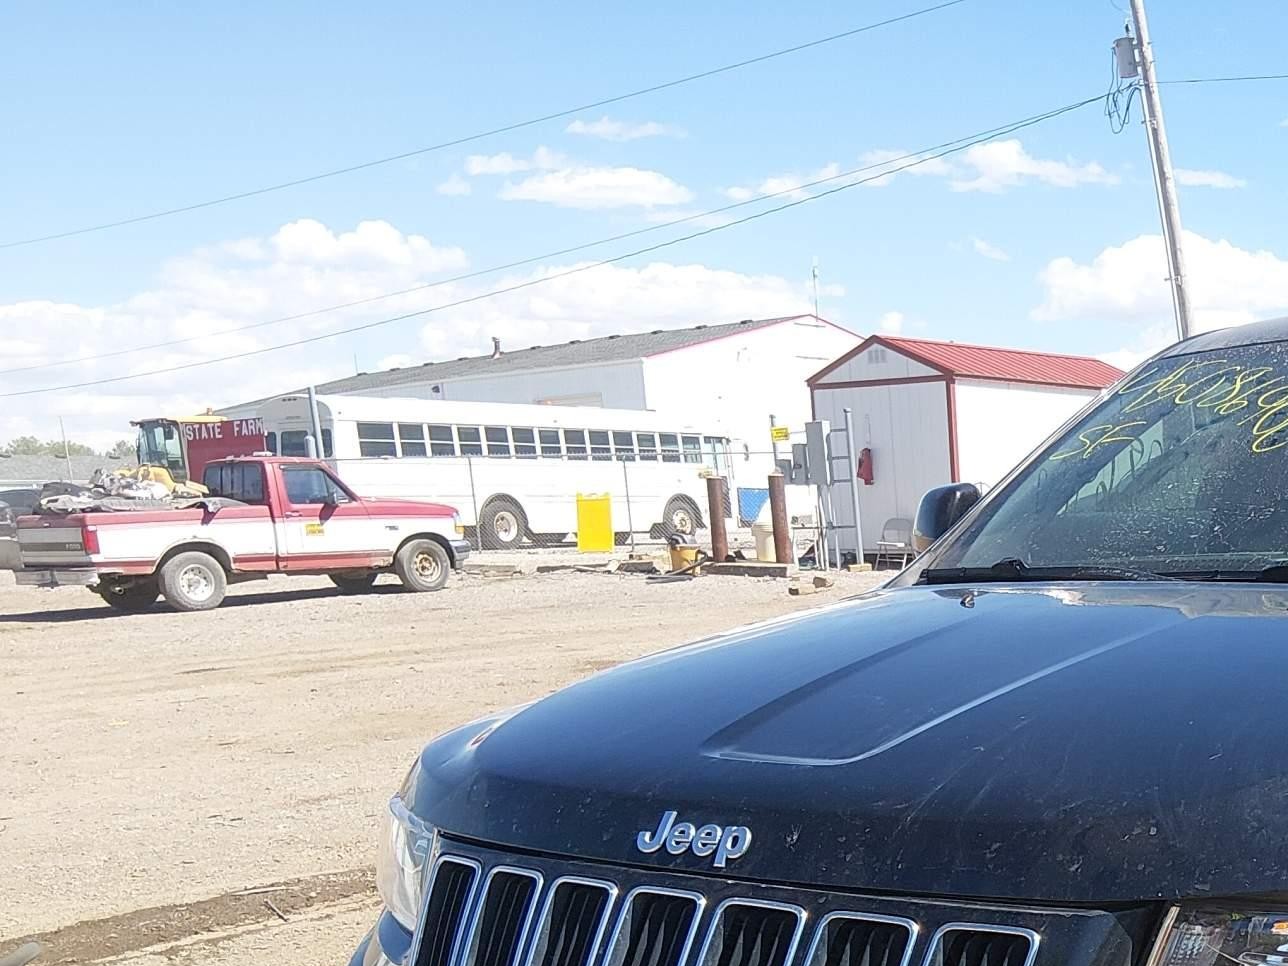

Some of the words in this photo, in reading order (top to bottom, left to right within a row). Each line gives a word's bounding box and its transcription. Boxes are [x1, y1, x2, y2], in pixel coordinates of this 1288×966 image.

[185, 422, 223, 440] STATE
[233, 418, 264, 437] FARM
[636, 810, 752, 868] Jeep
